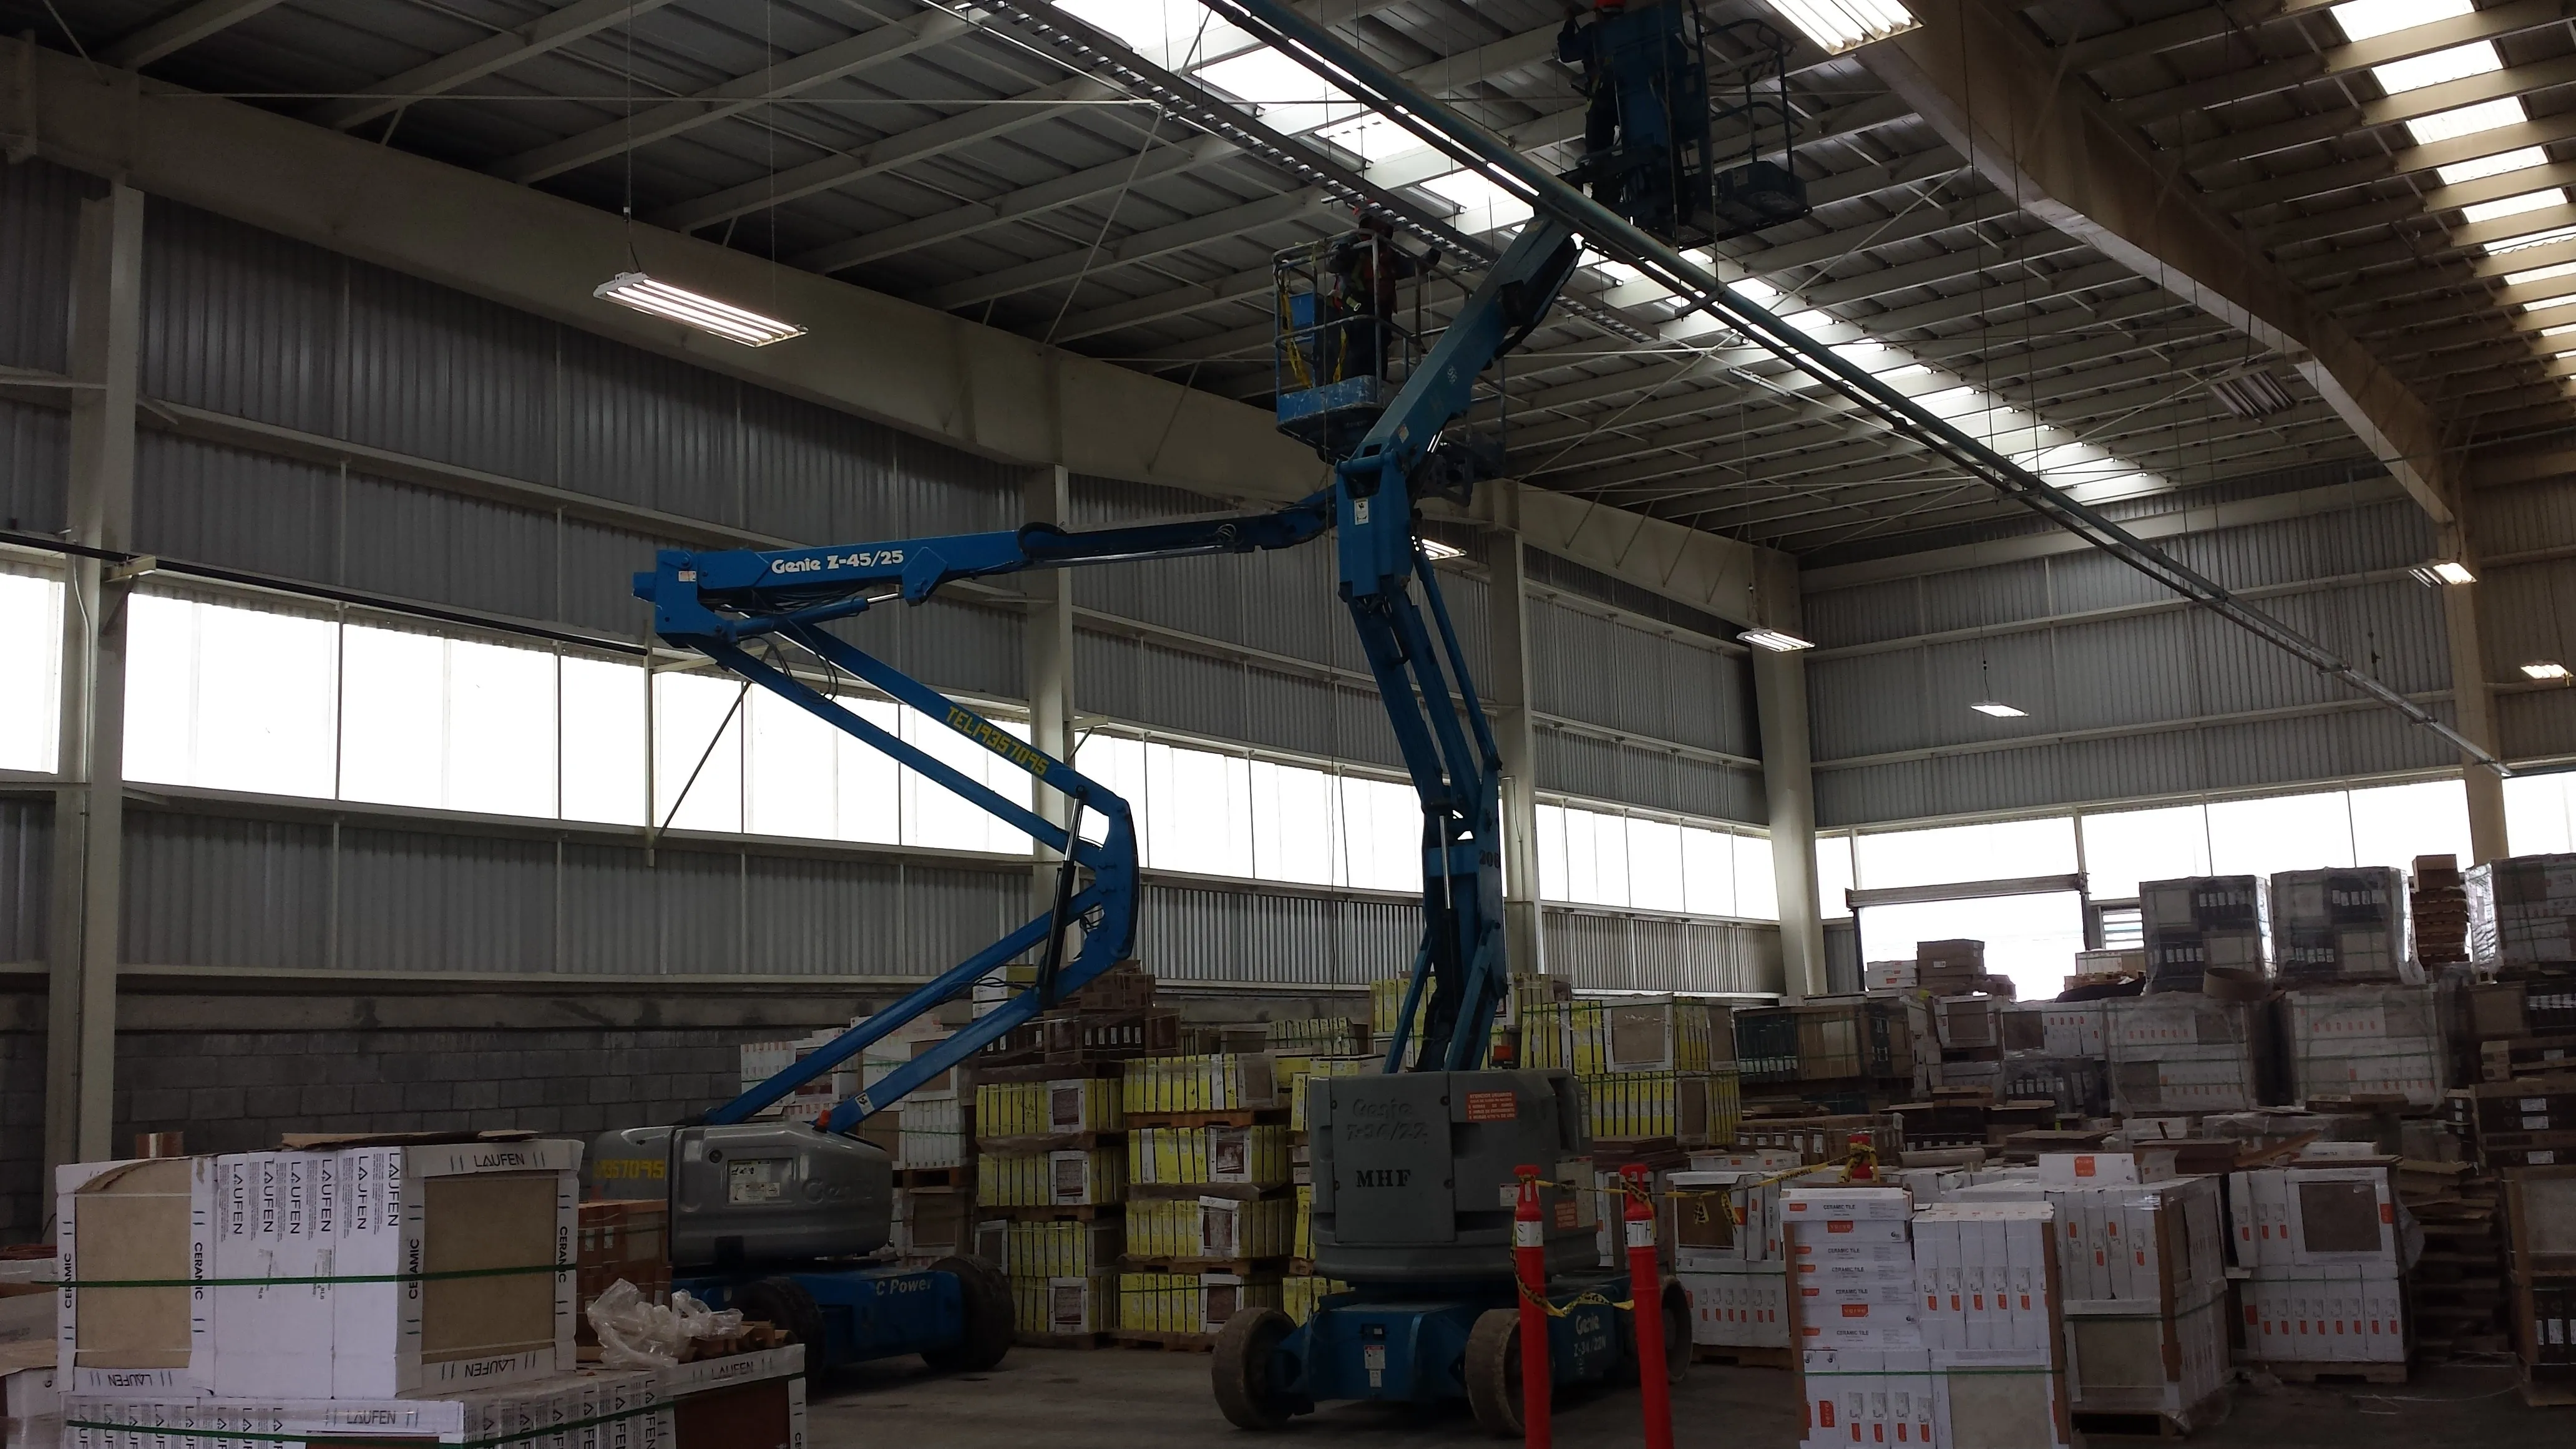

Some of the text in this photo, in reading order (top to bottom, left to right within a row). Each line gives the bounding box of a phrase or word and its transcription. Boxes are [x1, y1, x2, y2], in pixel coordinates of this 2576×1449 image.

[771, 550, 904, 575] Genie Z-45/25
[388, 1153, 400, 1227] LAUFEN
[474, 1153, 525, 1168] LAUFEN
[1356, 1169, 1412, 1188] MHF
[233, 1163, 243, 1234] LAUFEN
[263, 1159, 274, 1233] LAUFEN
[290, 1161, 301, 1234] LAUFEN
[321, 1159, 332, 1232] LAUFEN
[357, 1156, 369, 1230] LAUFEN
[409, 1238, 419, 1300] CEAMIC
[558, 1226, 568, 1284] CERAMC
[889, 1277, 934, 1295] Power
[107, 1373, 153, 1387] LAUFEN
[464, 1358, 516, 1378] LAUFEN
[347, 1410, 396, 1425] LAUFEN
[645, 1380, 656, 1449] LAFEN
